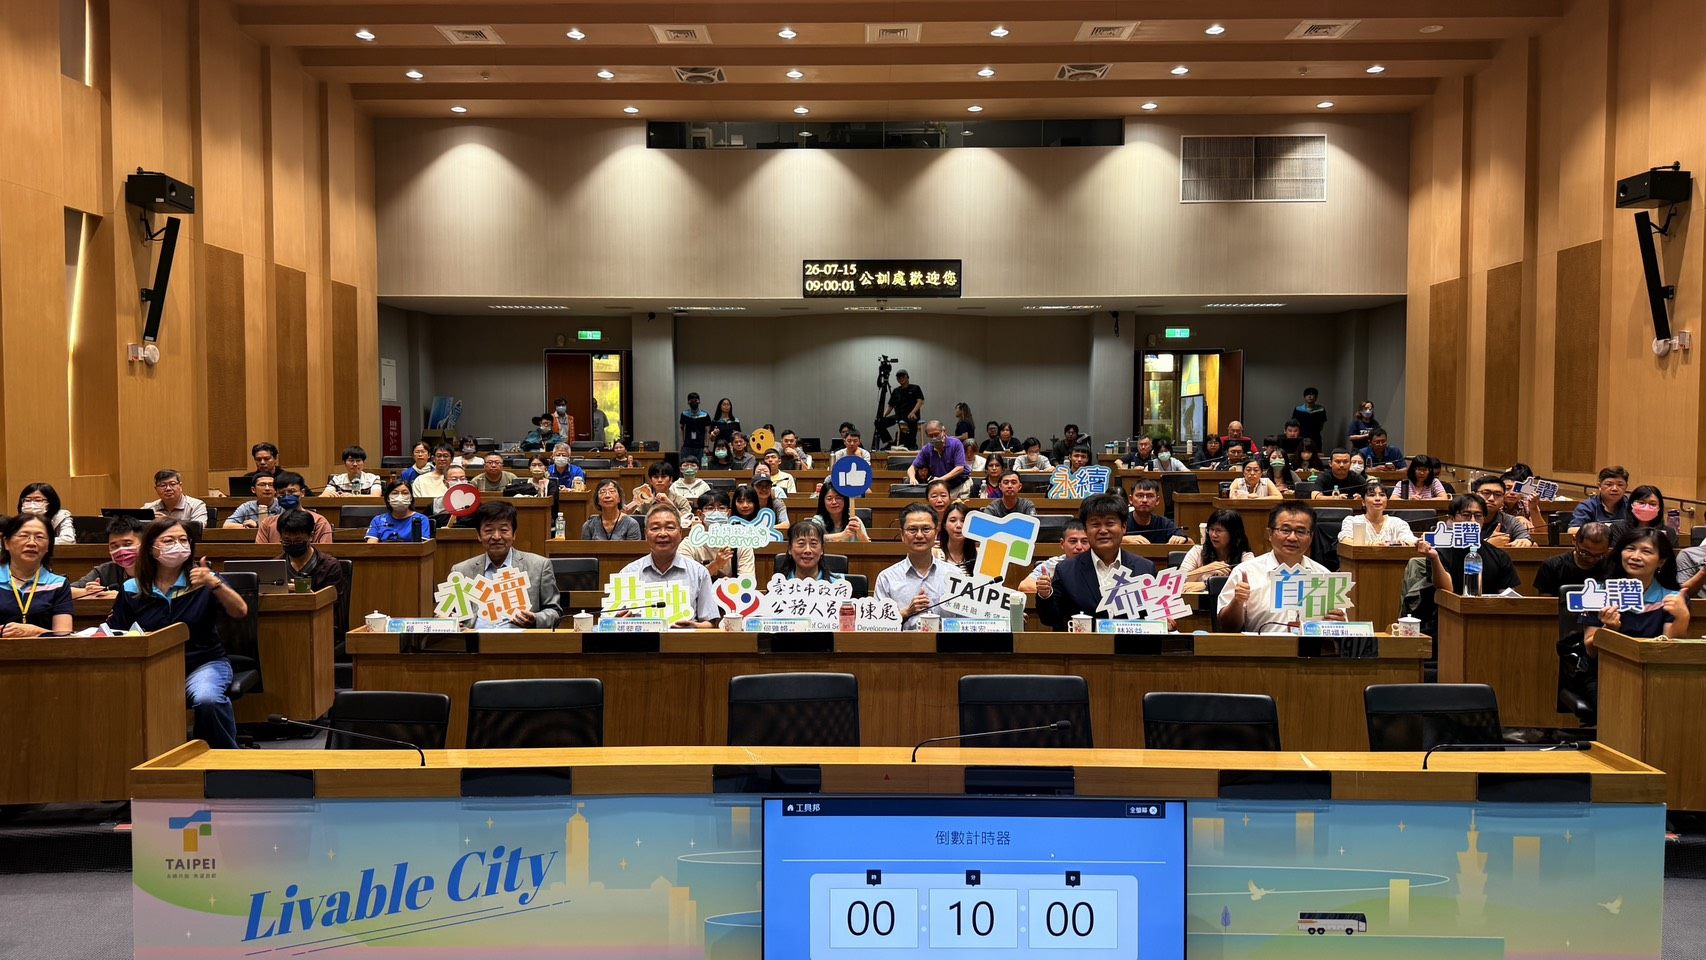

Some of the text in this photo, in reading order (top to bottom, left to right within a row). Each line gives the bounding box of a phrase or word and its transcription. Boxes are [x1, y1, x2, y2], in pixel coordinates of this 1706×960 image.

[805, 264, 857, 275] 26-07-15
[859, 270, 958, 286] 公訓處歡迎您
[805, 280, 855, 292] 09:00:01
[1052, 468, 1109, 498] 永續
[690, 525, 760, 547] Conserve
[1454, 522, 1481, 548] 讚
[437, 570, 527, 623] 永續
[603, 576, 692, 624] 共融
[773, 578, 849, 598] 臺北市政府
[949, 576, 1012, 611] TAIPE
[1104, 571, 1189, 619] 希望
[1273, 569, 1348, 618] 首都
[1605, 579, 1643, 611] 讚
[817, 622, 831, 630] Civil
[796, 803, 820, 812] 工具邦
[935, 830, 1011, 846] 倒數計時器
[165, 858, 216, 870] TAIPEI
[241, 844, 559, 942] Livable City
[846, 900, 1095, 938] 00 10 00
